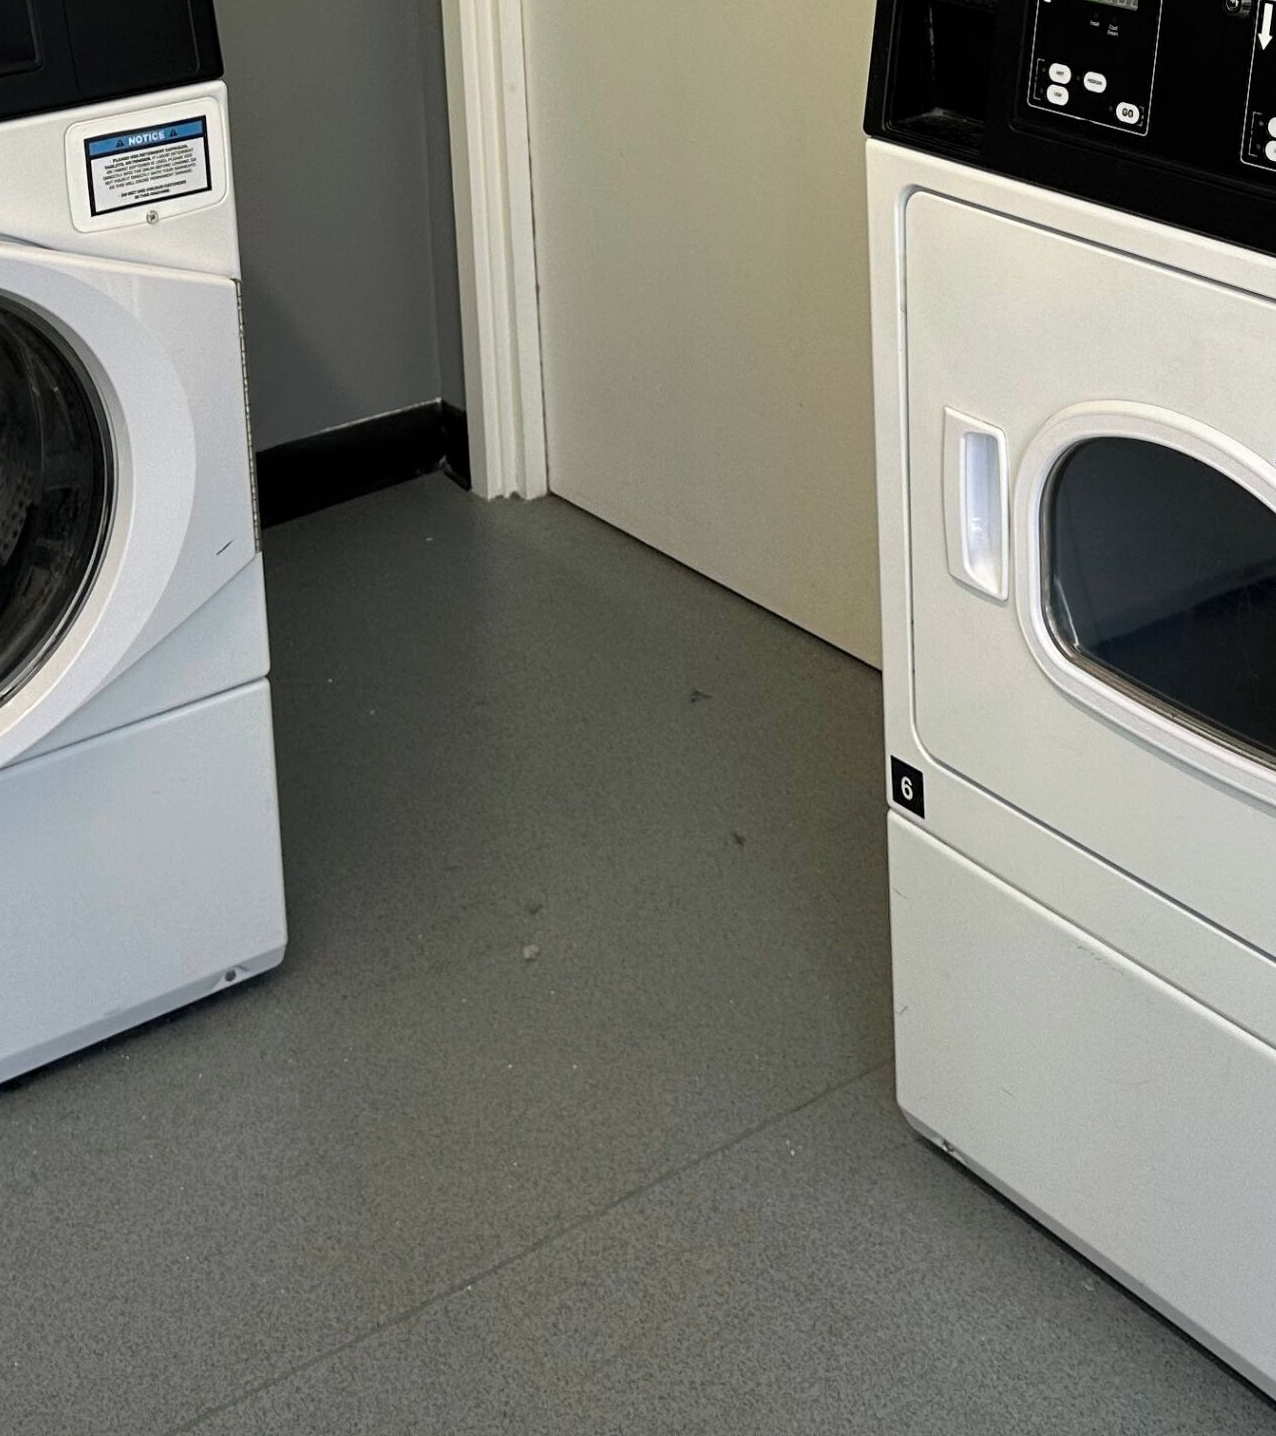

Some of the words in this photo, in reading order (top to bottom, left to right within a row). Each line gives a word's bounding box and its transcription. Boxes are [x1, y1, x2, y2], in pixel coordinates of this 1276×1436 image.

[1121, 107, 1135, 120] GO
[128, 131, 165, 146] NOTICE
[900, 776, 914, 801] 6
